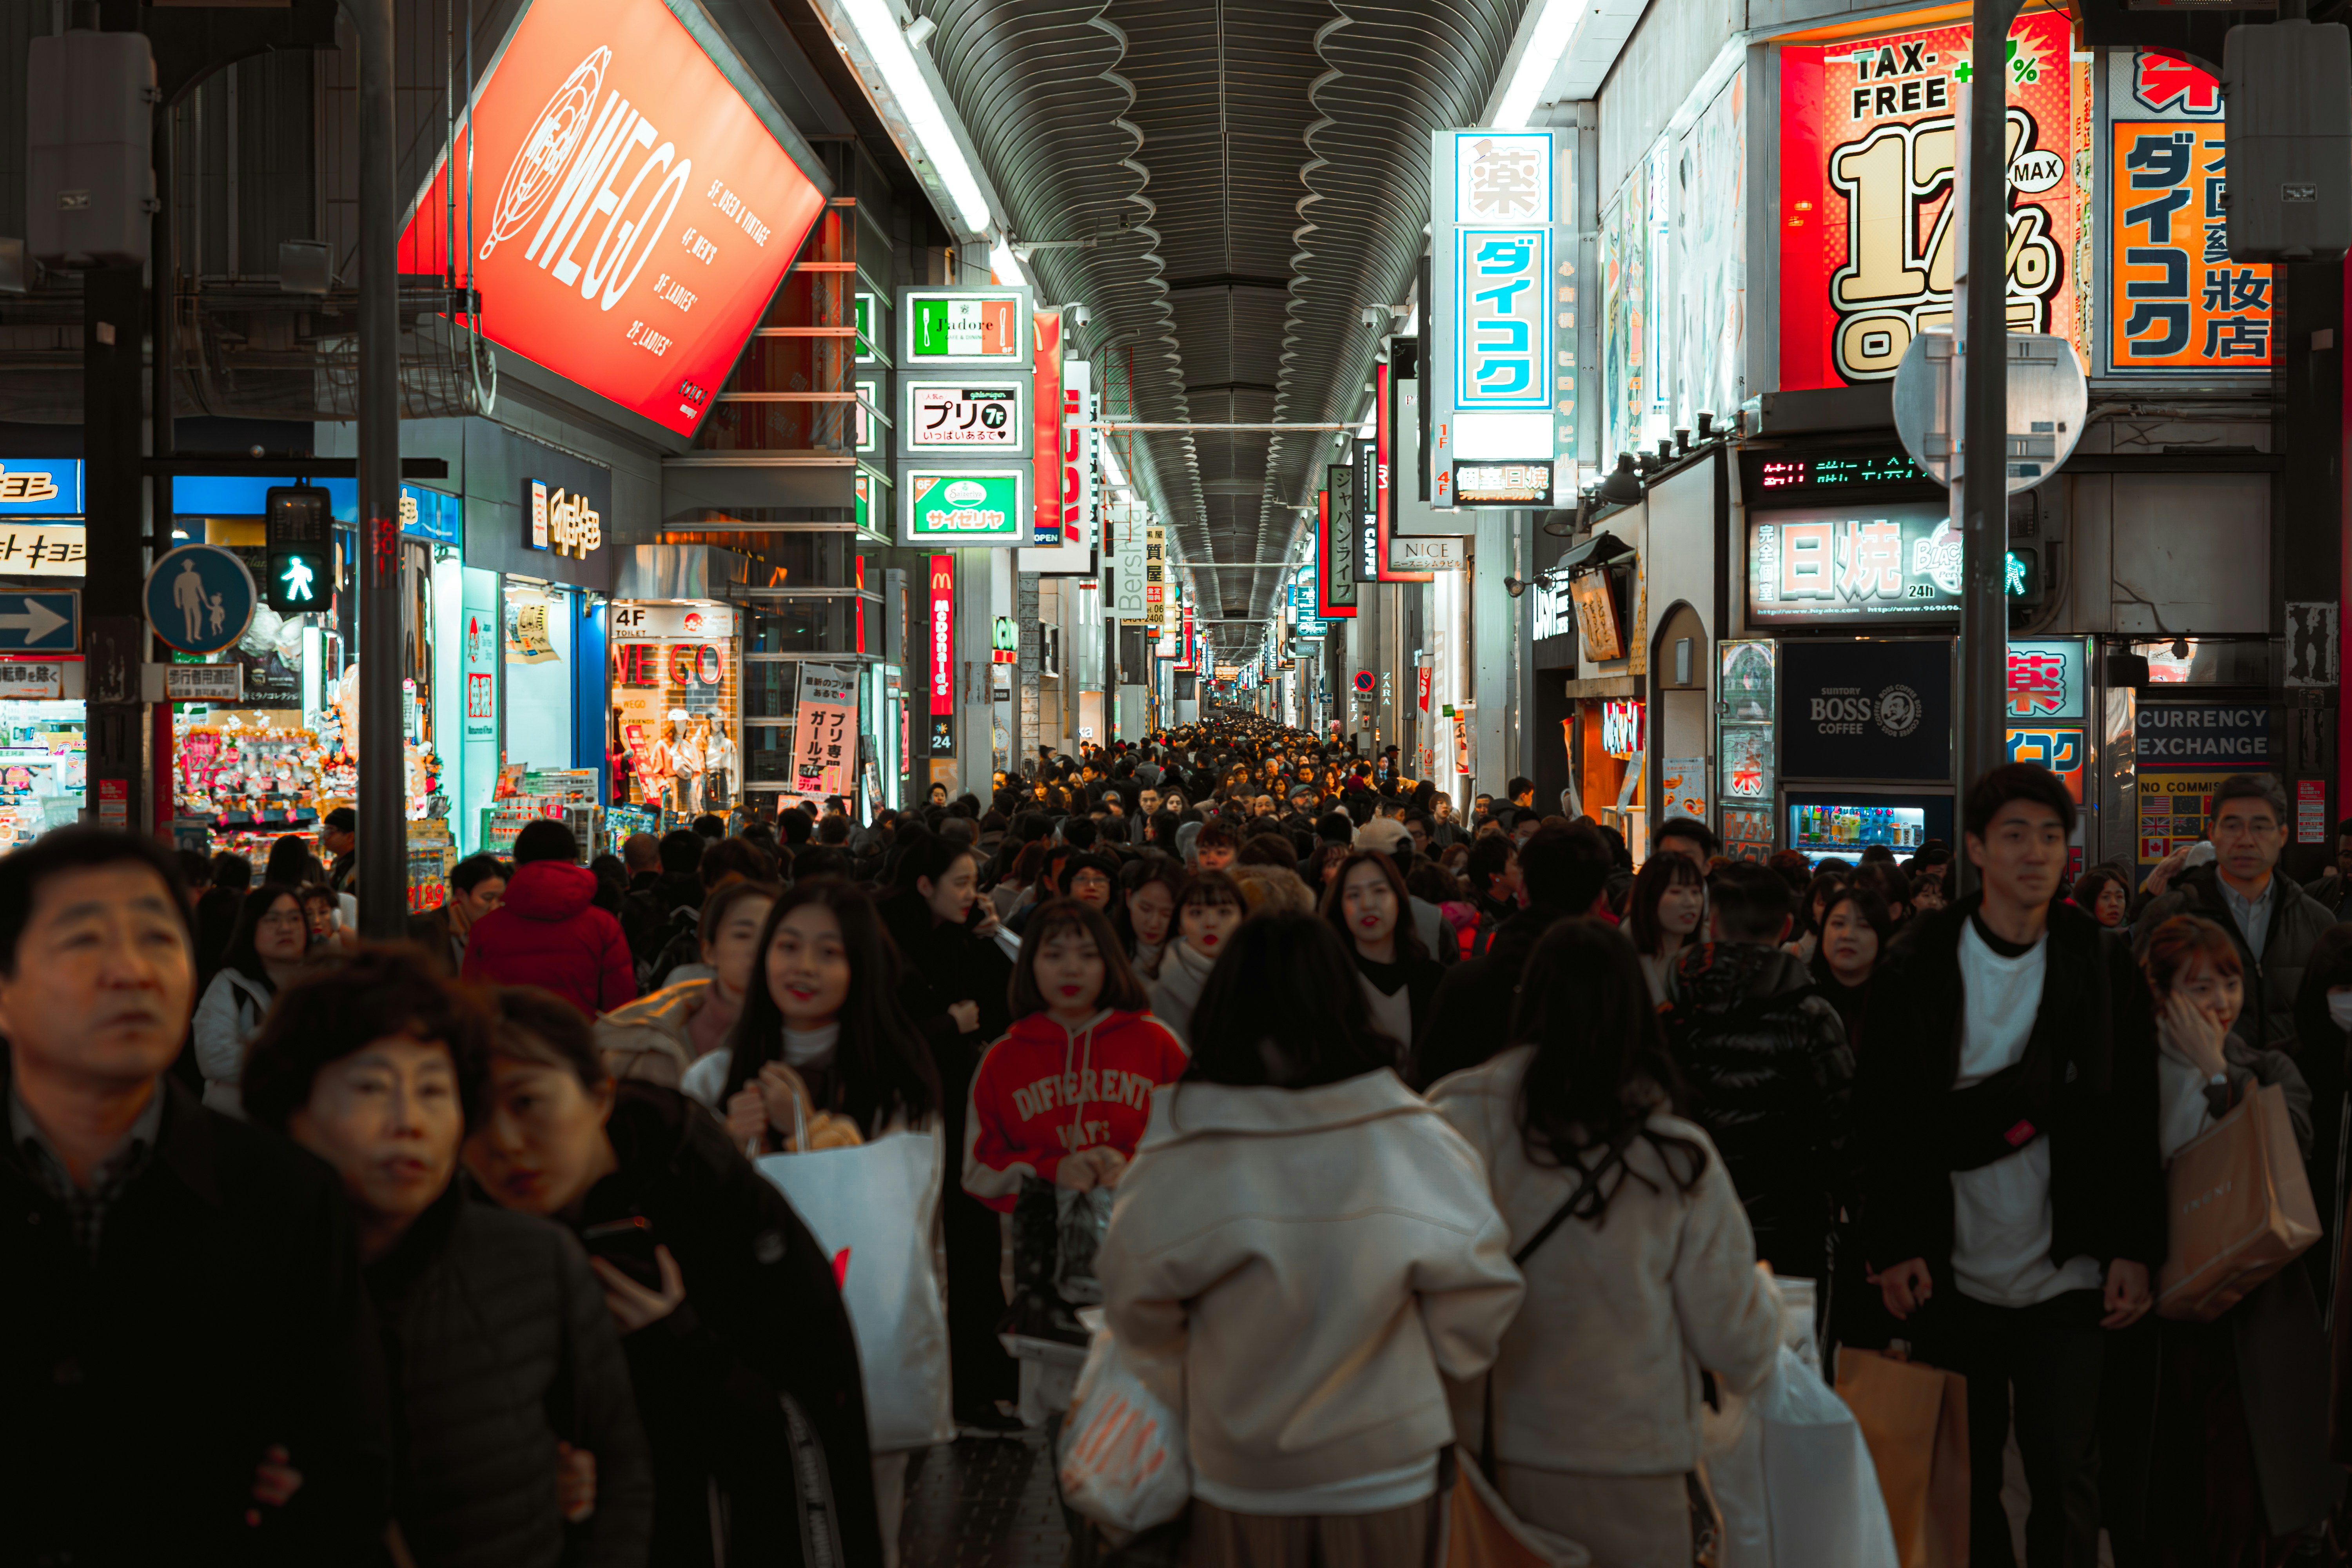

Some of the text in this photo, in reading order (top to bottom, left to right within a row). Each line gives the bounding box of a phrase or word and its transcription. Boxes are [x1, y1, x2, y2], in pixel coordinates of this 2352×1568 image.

[1852, 40, 1936, 81] TAX-
[1852, 76, 1948, 121] FREE
[1472, 150, 1537, 215] 薬
[2013, 160, 2058, 183] MAX
[524, 89, 691, 311] WEGO
[741, 211, 771, 247] VINTAGE
[2125, 131, 2194, 358] ダイコク
[936, 318, 994, 332] J'adore
[1475, 239, 1534, 393] ダイコク
[924, 401, 1004, 430] プリ 7F
[924, 430, 996, 440] いっぱいあるで
[0, 477, 54, 497] ヨシ
[916, 480, 931, 490] 6F
[949, 489, 982, 499] Saizeriya
[1437, 470, 1450, 496] 4F
[928, 510, 1003, 528] サイゼリヤ
[1336, 472, 1352, 598] ジャパンライフ
[0, 534, 86, 568] トキヨシ
[1118, 509, 1142, 611] Bershka
[1405, 543, 1449, 558] NICE
[1782, 520, 1902, 593] 日焼
[1147, 543, 1162, 582] 質屋
[1759, 524, 1774, 602] 完全個室
[1908, 585, 1935, 599] 24h
[616, 610, 645, 626] 4F
[935, 599, 949, 695] McDonald's
[0, 666, 57, 682] 転車を除く
[1382, 672, 1392, 705] ZARA
[623, 700, 645, 709] WEGO
[1810, 698, 1871, 721] BOSS
[1818, 723, 1863, 734] COFFEE
[2137, 710, 2267, 728] CURRENCY
[932, 735, 951, 748] 24
[2137, 737, 2267, 755] EXCHANGE
[2140, 782, 2160, 793] NO
